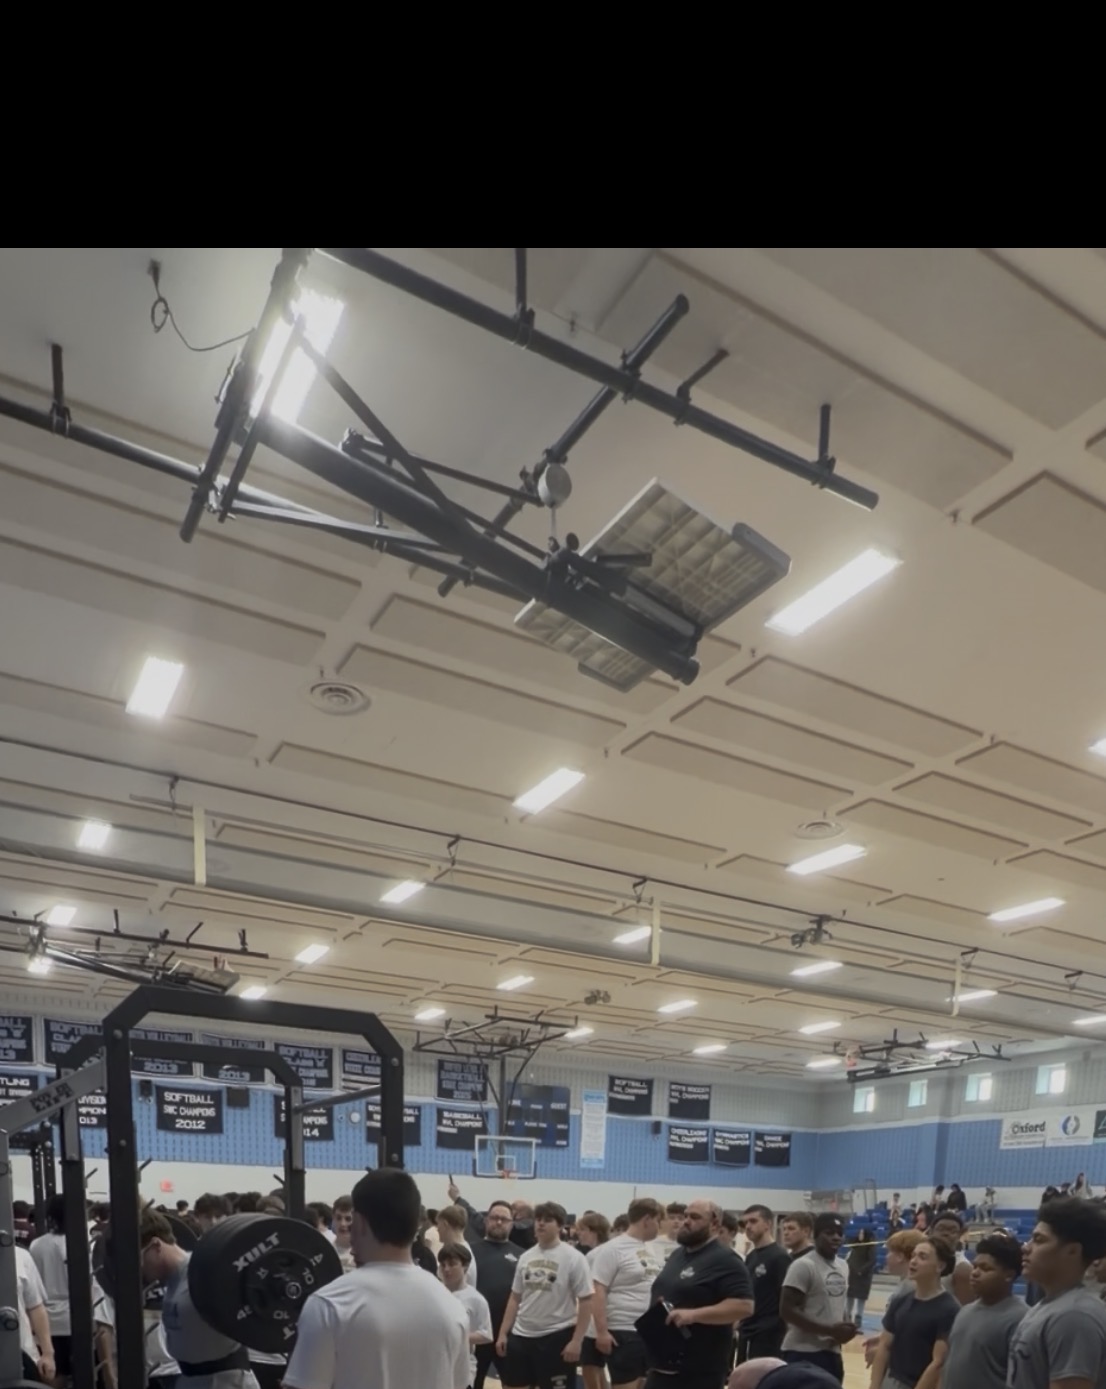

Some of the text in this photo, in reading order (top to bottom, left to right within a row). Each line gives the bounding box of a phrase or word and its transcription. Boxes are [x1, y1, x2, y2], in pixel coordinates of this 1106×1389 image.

[163, 1091, 214, 1104] SOFTBALL
[175, 1118, 206, 1130] 2012
[1012, 1121, 1046, 1135] Oxford
[232, 1232, 280, 1272] XULT
